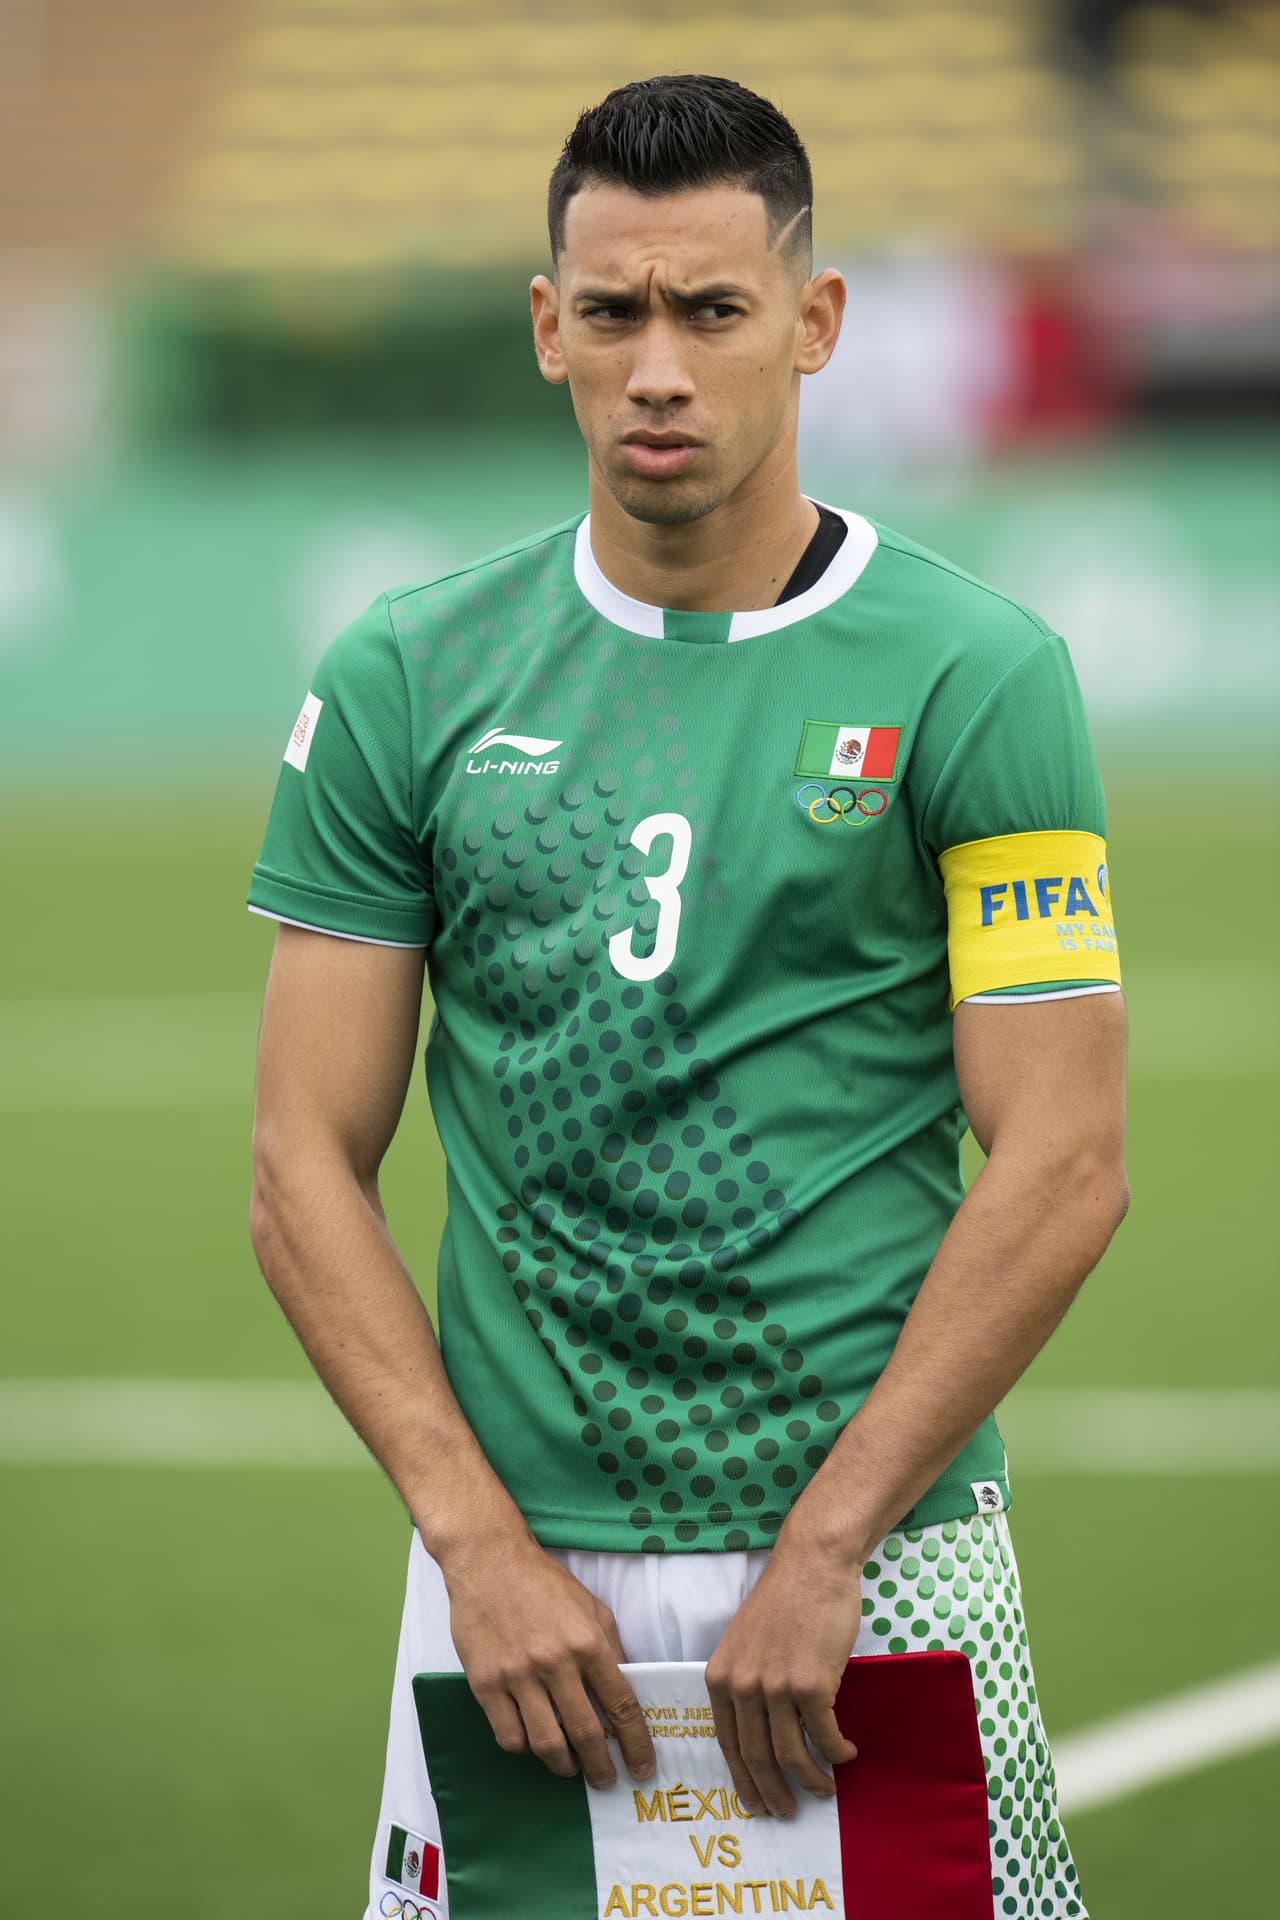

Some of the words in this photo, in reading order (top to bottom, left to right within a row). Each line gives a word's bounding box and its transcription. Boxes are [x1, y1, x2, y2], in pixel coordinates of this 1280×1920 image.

[466, 759, 560, 775] LI-NING
[608, 812, 693, 982] 3
[980, 876, 1099, 927] FIFA
[1055, 922, 1084, 937] MY
[1060, 938, 1077, 951] IS
[682, 1706, 713, 1721] JUE
[689, 1833, 742, 1868] VS
[603, 1877, 835, 1918] ARGENTINA
